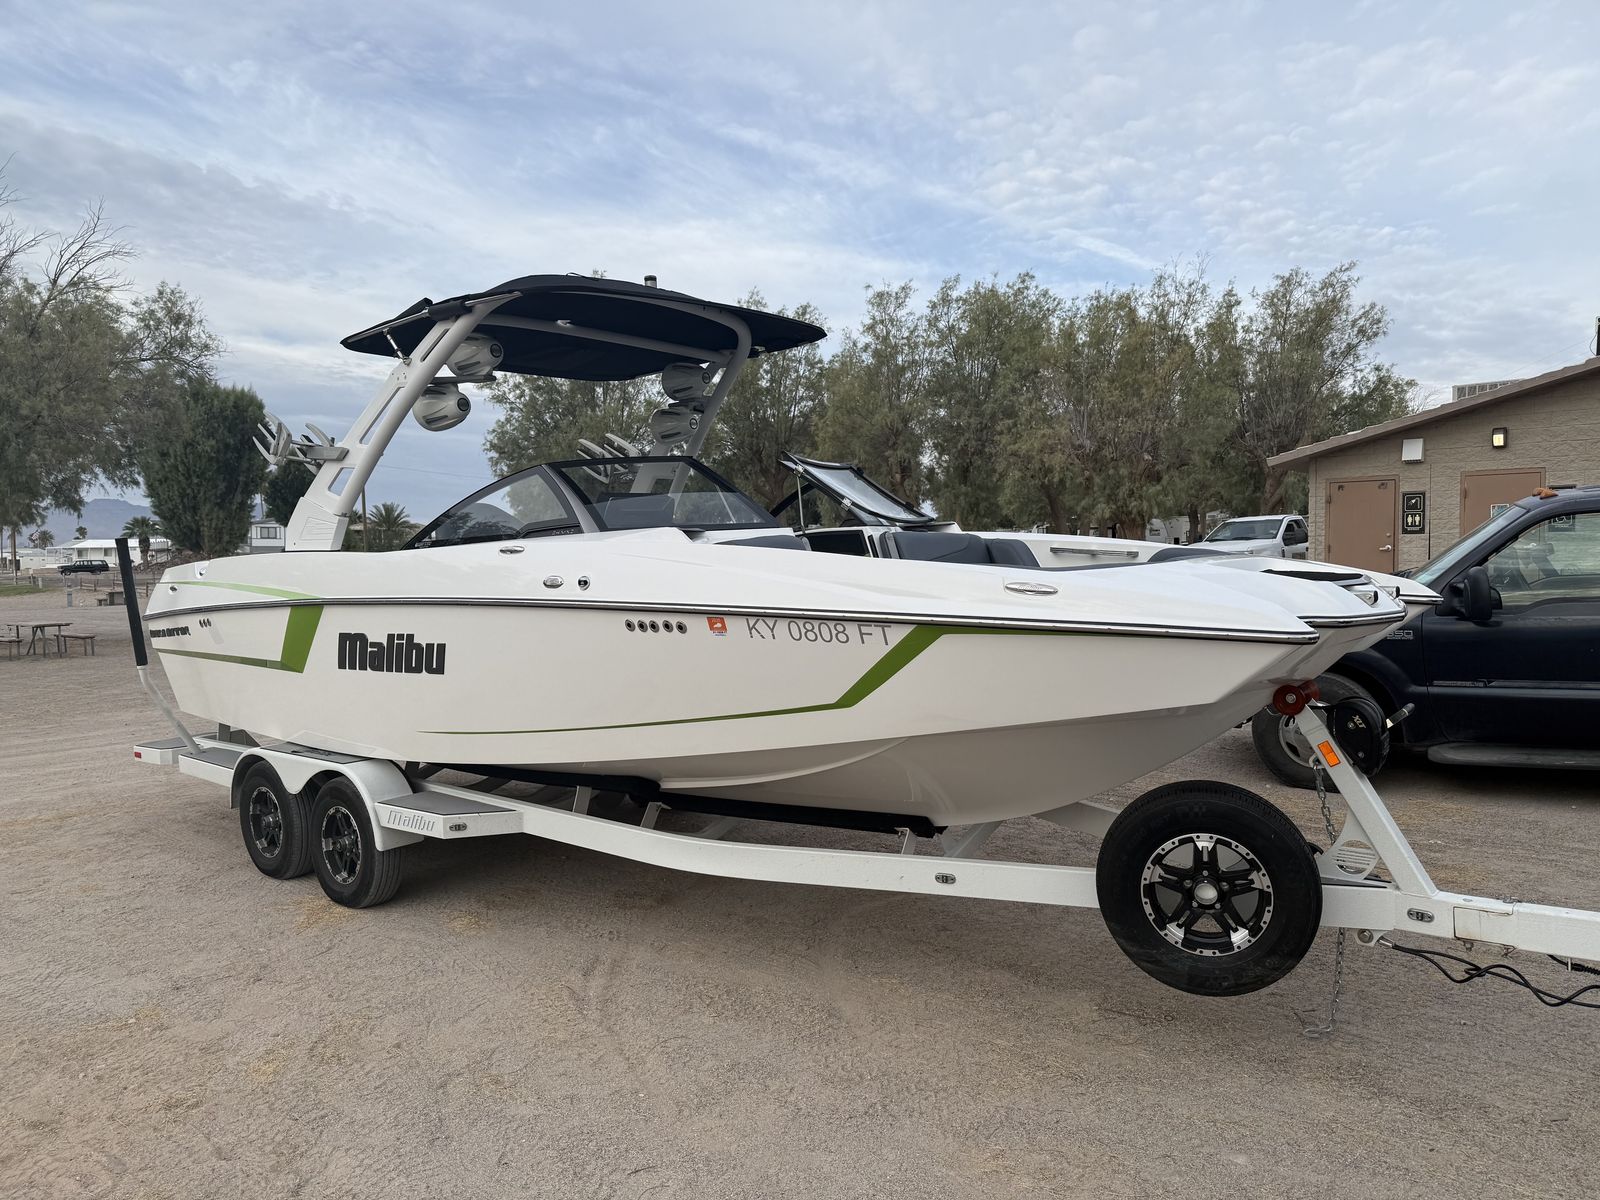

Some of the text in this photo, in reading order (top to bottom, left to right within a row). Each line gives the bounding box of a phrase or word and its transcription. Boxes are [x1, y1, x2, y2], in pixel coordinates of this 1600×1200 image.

[745, 617, 892, 646] KY 0808 FT
[337, 632, 446, 675] Malibu
[1352, 715, 1366, 728] XLT
[387, 810, 436, 831] Malibu
